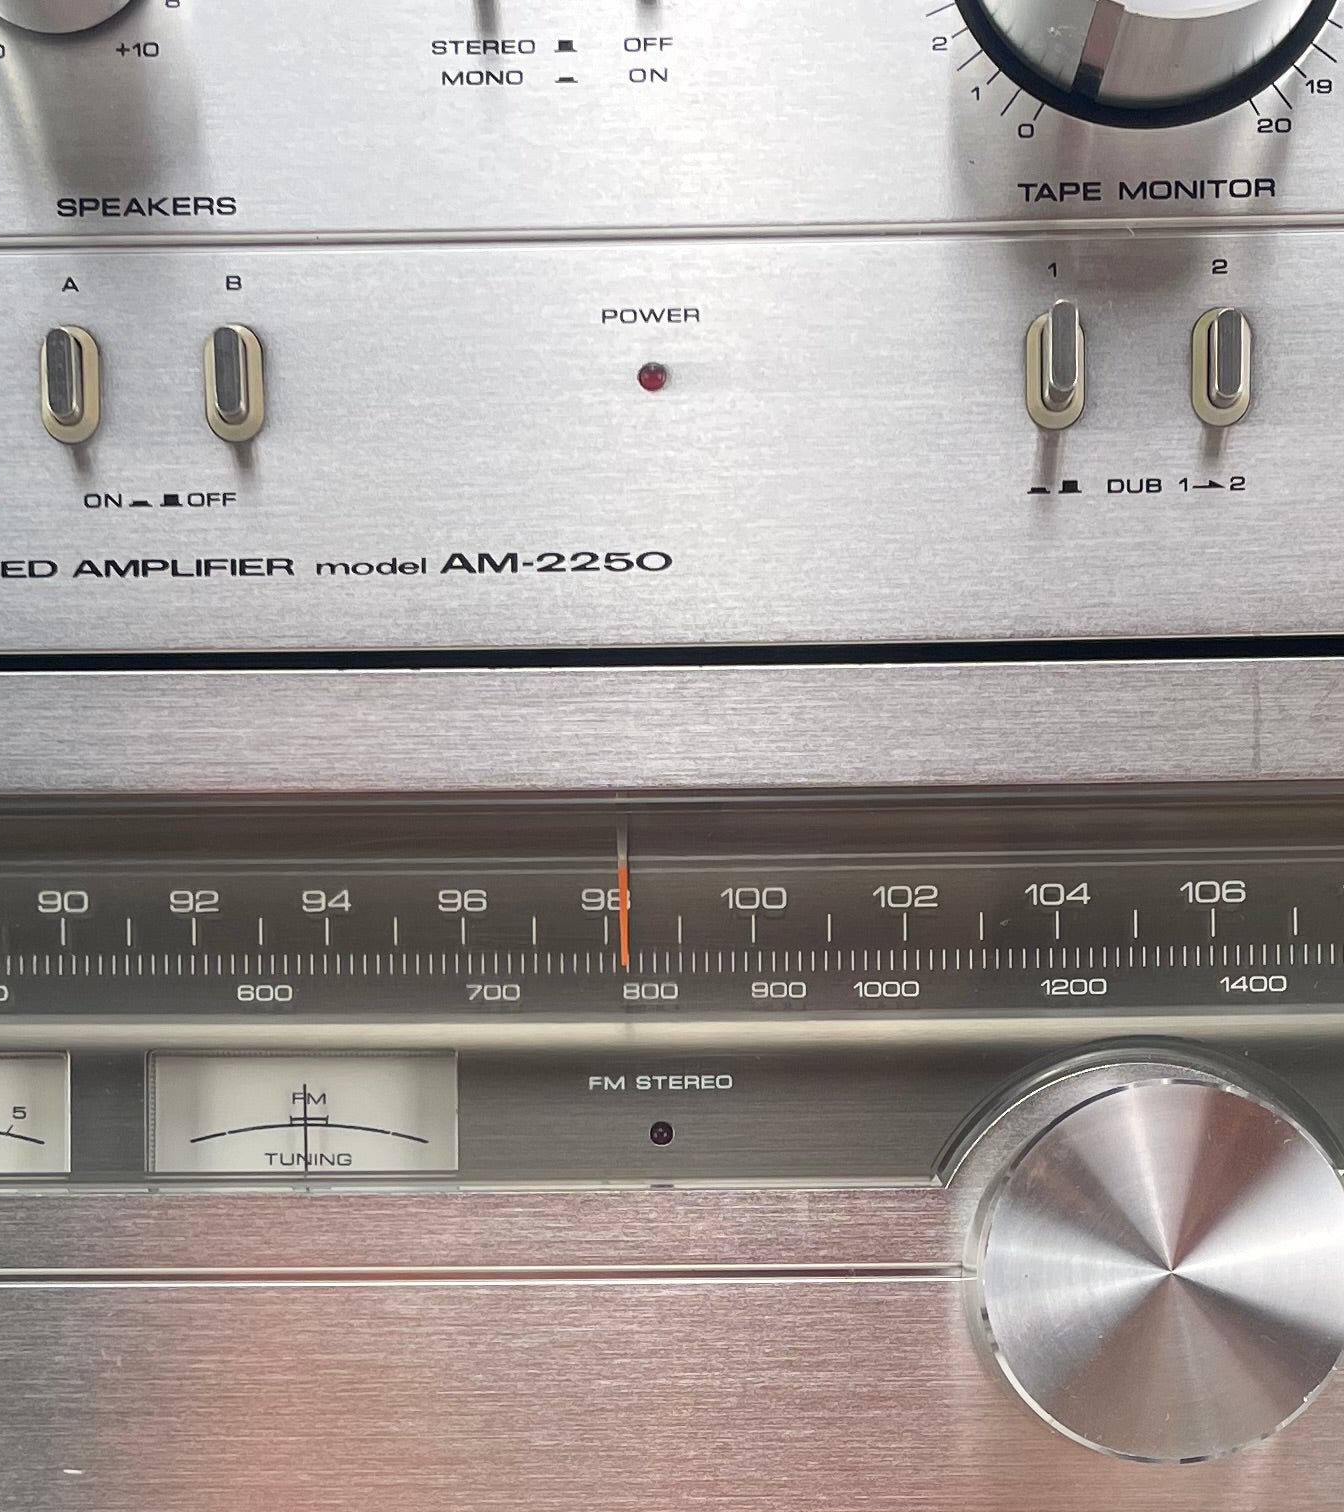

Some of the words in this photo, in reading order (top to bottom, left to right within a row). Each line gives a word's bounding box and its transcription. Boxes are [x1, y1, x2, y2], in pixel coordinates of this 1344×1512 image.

[431, 39, 536, 56] STEREO
[623, 36, 673, 53] OFF
[931, 36, 948, 51] 2
[441, 69, 524, 86] MONO
[628, 67, 668, 83] ON
[1305, 78, 1333, 95] 19
[1017, 123, 1035, 139] 0
[1257, 117, 1292, 134] 20
[1017, 181, 1102, 203] TAPE
[1118, 178, 1276, 201] MONITOR
[56, 196, 237, 218] SPEAKERS
[1047, 262, 1057, 278] 1
[1211, 258, 1228, 275] 2
[61, 276, 80, 293] A
[225, 275, 243, 291] B
[601, 307, 700, 325] POWER
[1107, 478, 1163, 494] DUB
[1178, 477, 1188, 492] 1
[1229, 475, 1246, 492] 2
[83, 493, 123, 509] ON
[187, 492, 237, 508] OFF
[72, 557, 295, 579] AMPLIFIER
[315, 557, 427, 576] model
[439, 550, 674, 575] AM-2250
[37, 890, 89, 913] 90
[169, 890, 219, 913] 92
[302, 889, 352, 913] 94
[438, 889, 488, 912] 96
[580, 888, 631, 912] 98
[720, 886, 787, 910] 100
[872, 885, 939, 908] 102
[1024, 882, 1091, 906] 104
[1179, 880, 1247, 904] 106
[237, 984, 293, 1002] 600
[466, 983, 521, 1001] 700
[623, 982, 679, 1000] 800
[751, 981, 807, 999] 900
[853, 980, 920, 998] 1000
[1040, 978, 1107, 996] 1200
[1219, 975, 1288, 993] 1400
[588, 1075, 626, 1091] FM
[635, 1074, 733, 1090] STEREO
[291, 1091, 327, 1106] FM
[264, 1152, 353, 1167] TUNING
